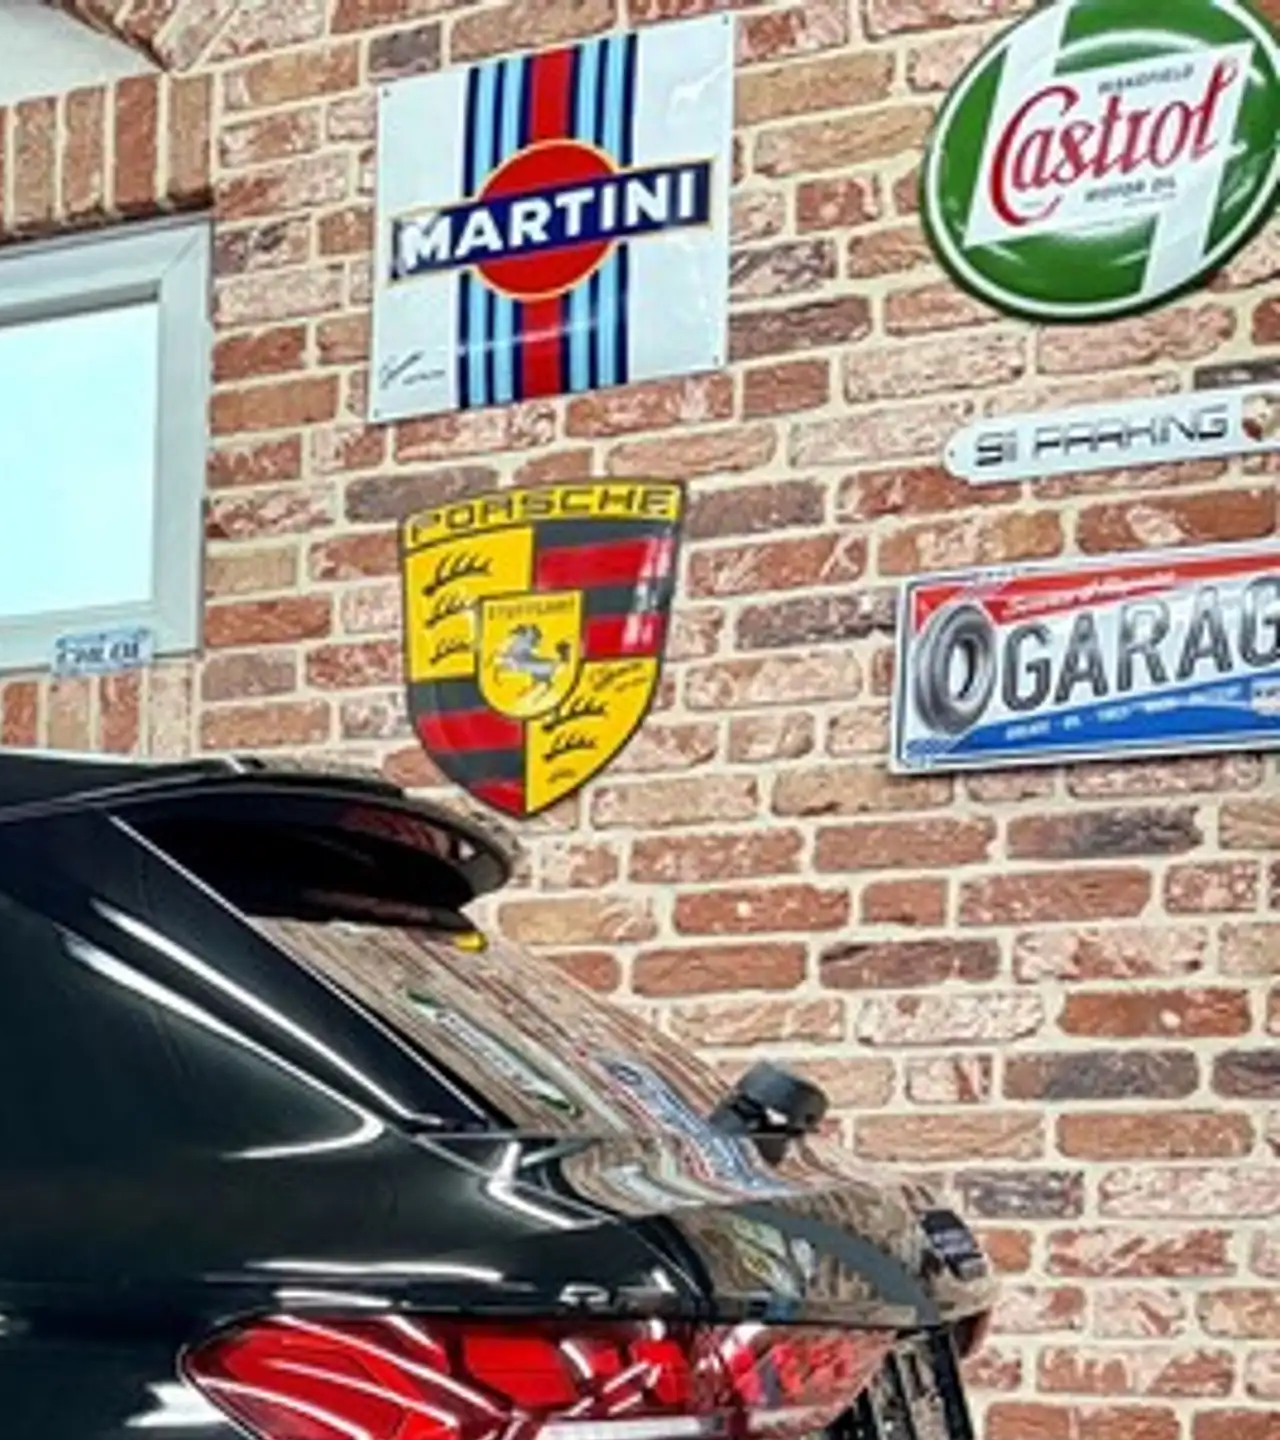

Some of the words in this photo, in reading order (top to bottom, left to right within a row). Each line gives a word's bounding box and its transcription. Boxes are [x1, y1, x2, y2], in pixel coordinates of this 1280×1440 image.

[989, 57, 1238, 226] Castrol
[398, 169, 697, 277] MARTINI
[1031, 404, 1228, 461] PARKING
[410, 487, 673, 543] PORSCHE
